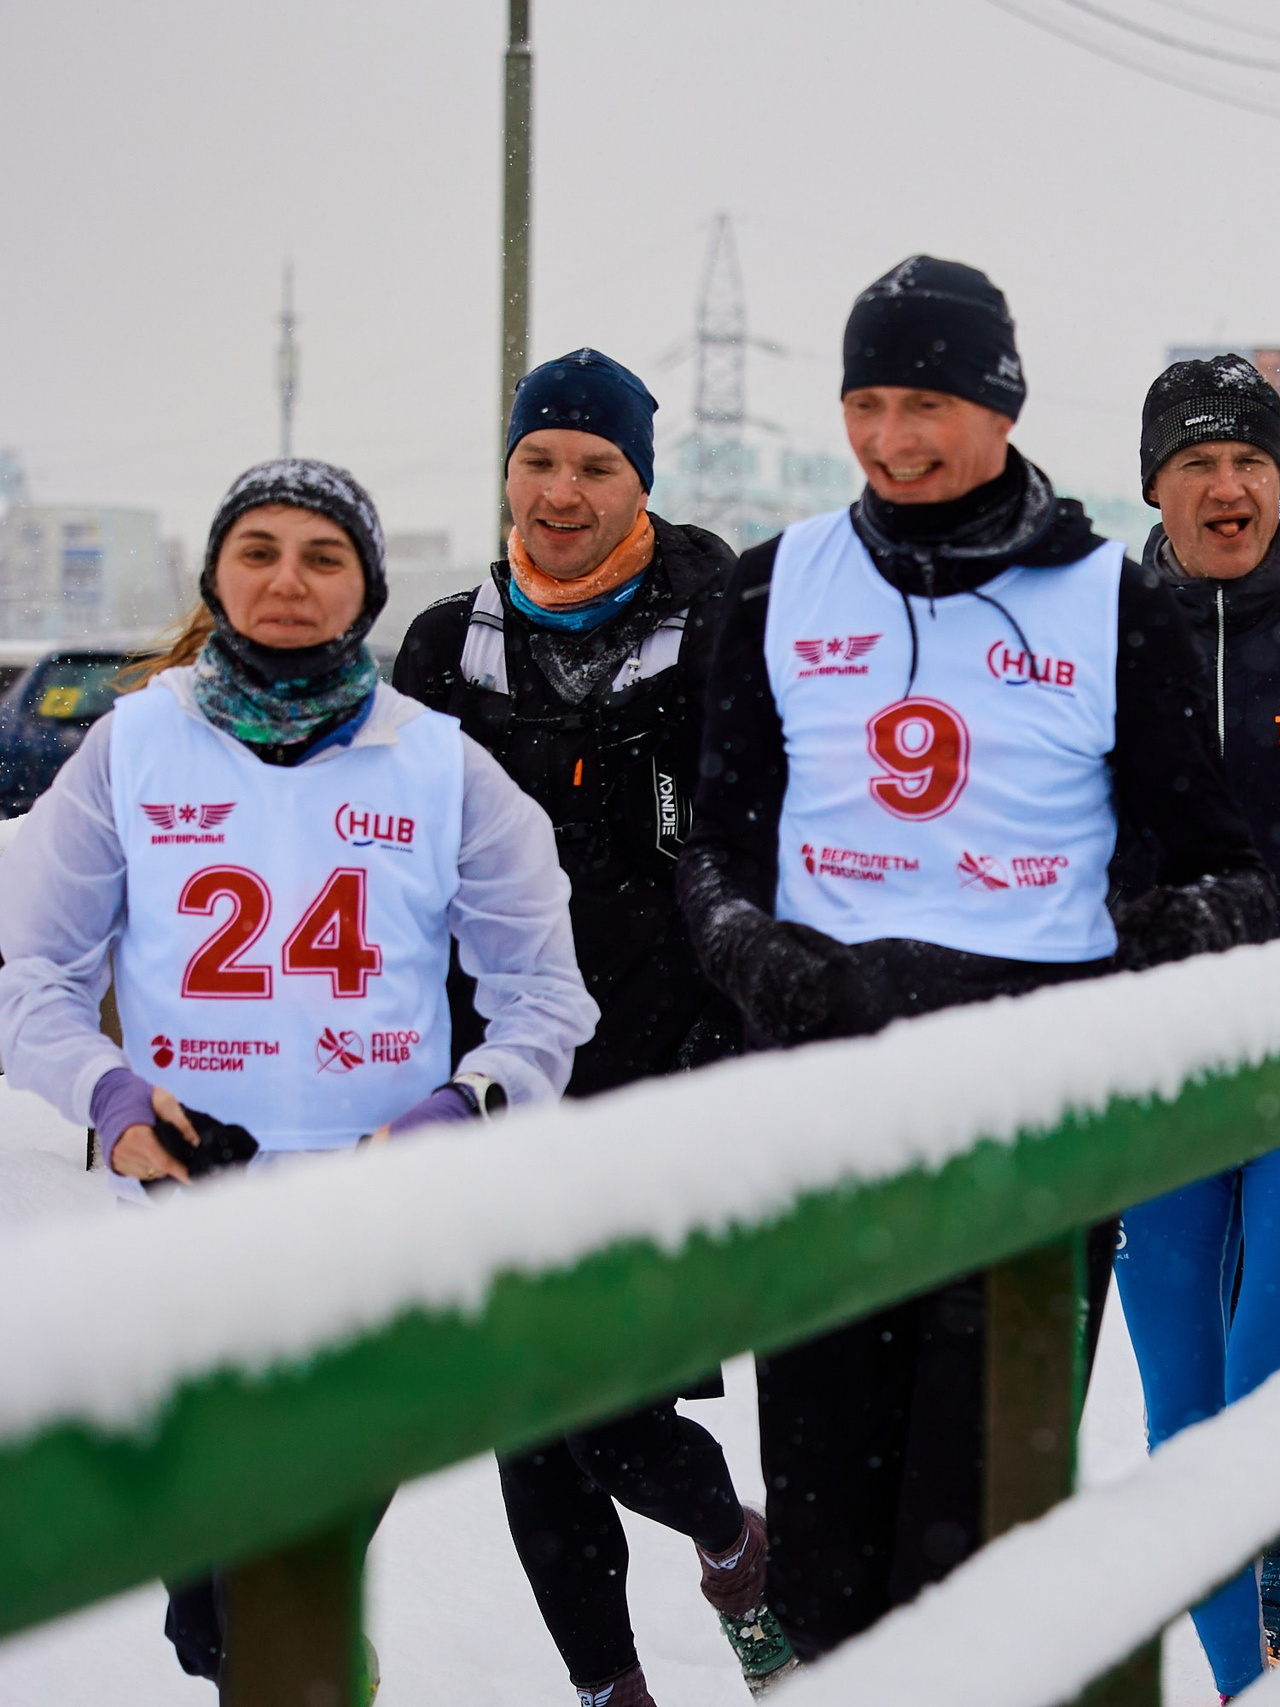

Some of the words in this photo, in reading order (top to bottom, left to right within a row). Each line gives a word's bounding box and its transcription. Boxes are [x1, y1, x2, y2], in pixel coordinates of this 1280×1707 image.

[867, 697, 970, 821] 9
[349, 811, 415, 844] НЦВ
[822, 847, 919, 871] ВЕРТОЛЕТЫ
[819, 863, 885, 882] РОССИИ
[178, 865, 382, 1000] 24
[180, 1038, 279, 1056] ВЕРТОЛЕТЫ
[372, 1047, 411, 1064] НЦВ
[180, 1055, 244, 1071] РОССИИ
